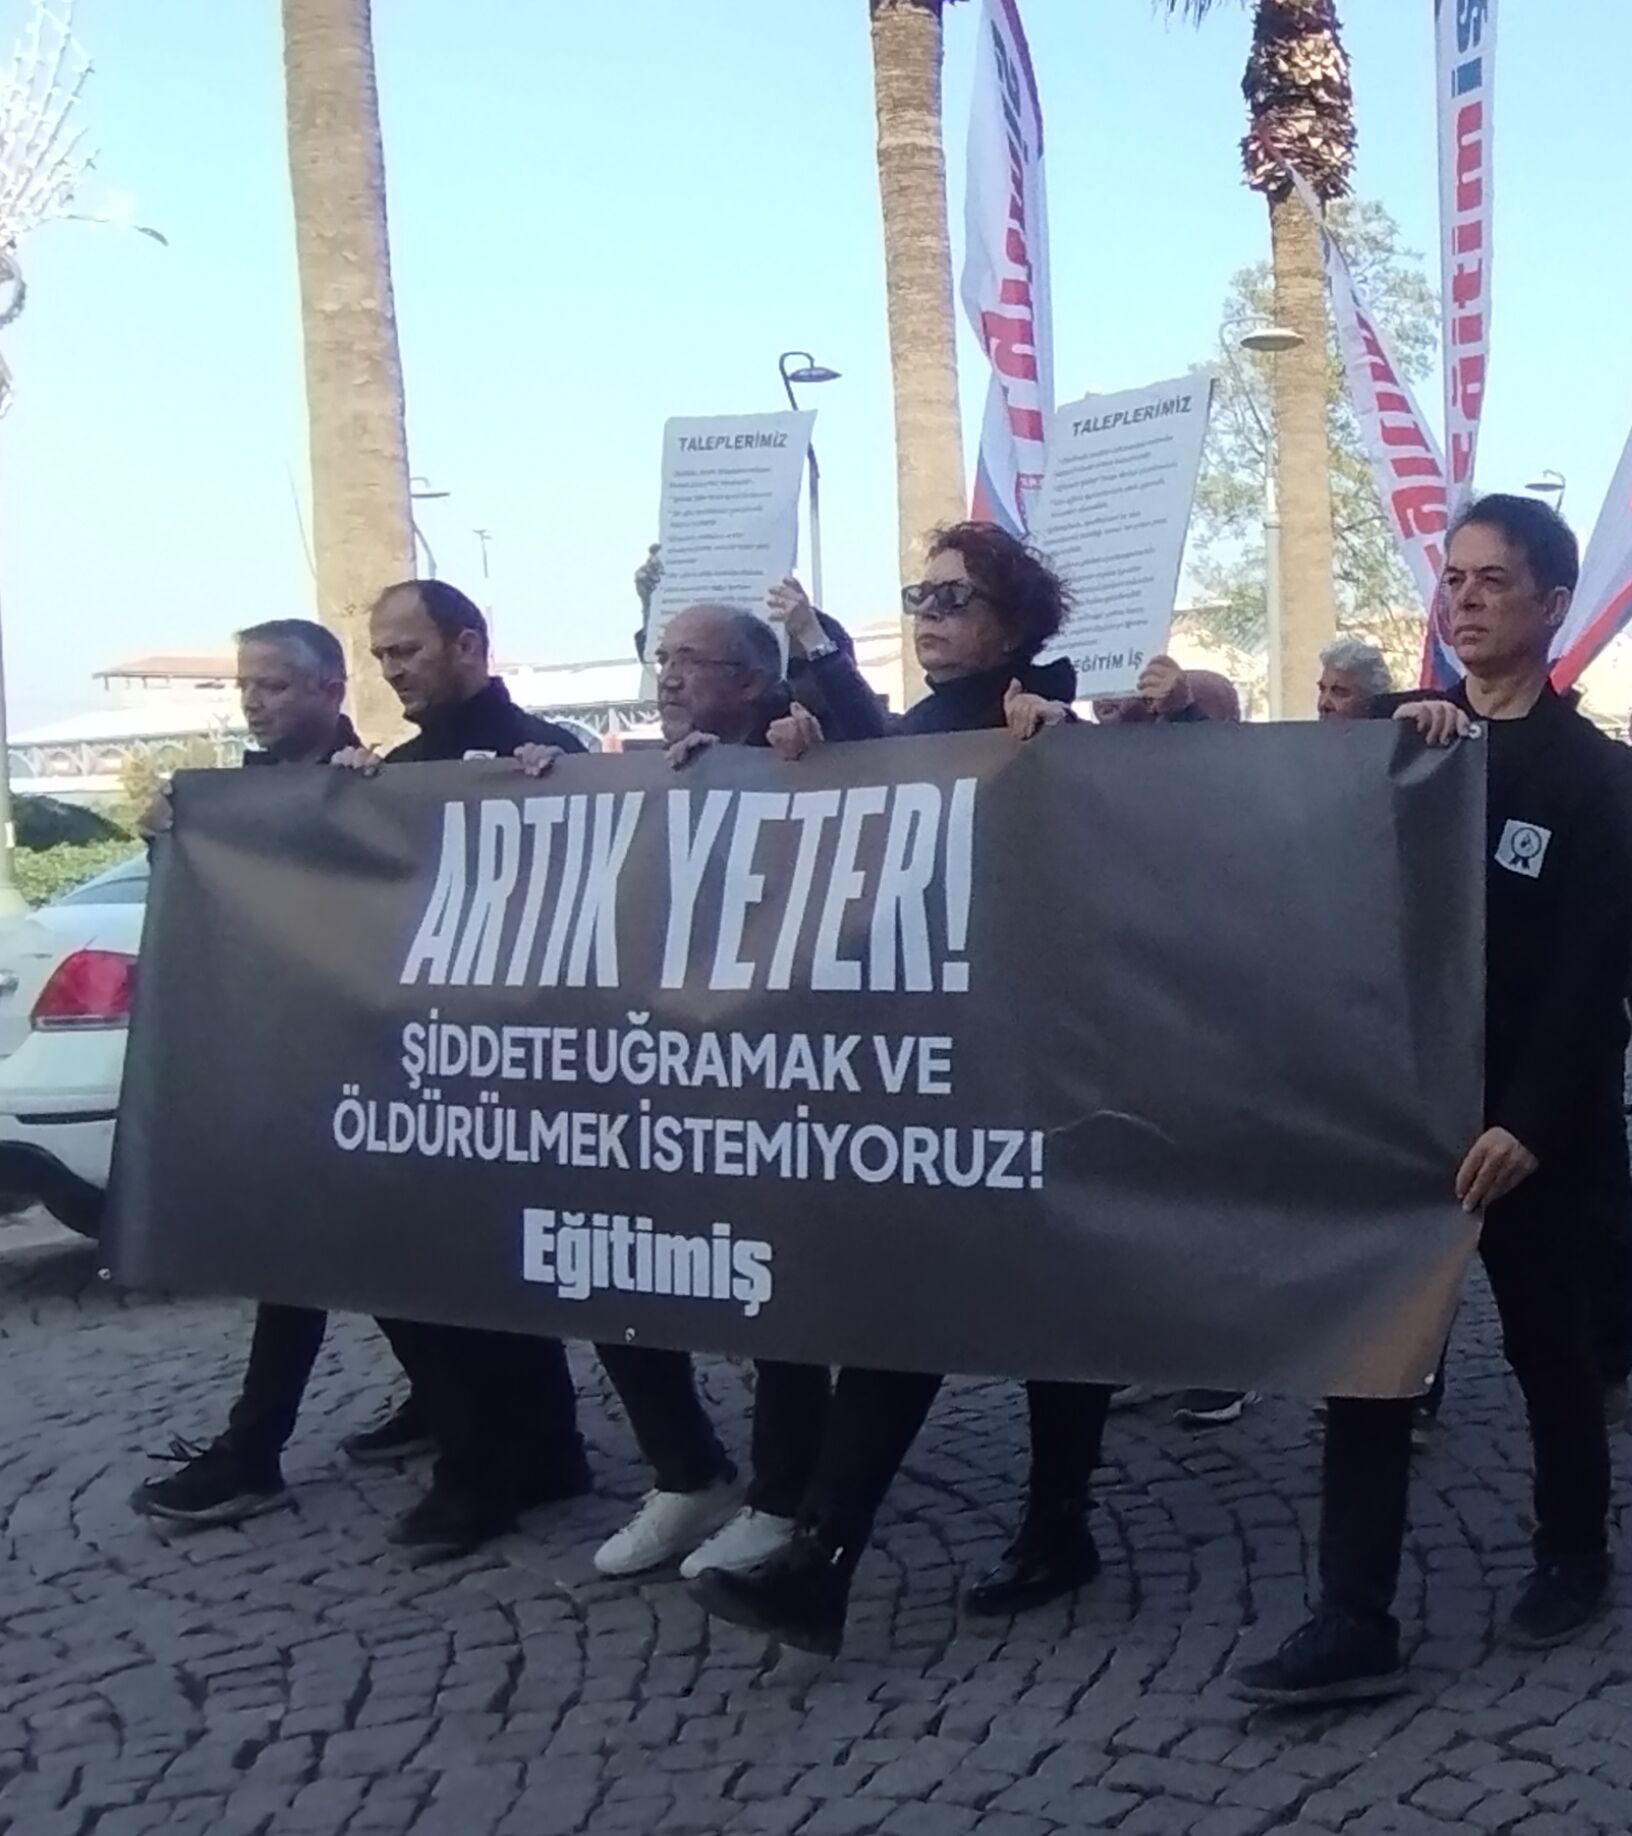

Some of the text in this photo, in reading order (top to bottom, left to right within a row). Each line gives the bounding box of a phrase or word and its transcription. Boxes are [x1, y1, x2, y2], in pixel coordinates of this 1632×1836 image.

[678, 431, 788, 452] TALEPLERİMİZ
[1072, 395, 1192, 437] TALEPLERİMİZ
[399, 776, 975, 994] ARTIK YETER!
[401, 1008, 953, 1095] ŞİDDETE UĞRAMAK VE
[333, 1084, 1044, 1189] ÖLDÜRÜLMEK İSTEMİYORUZ!
[521, 1208, 773, 1318] Eğitimiş
